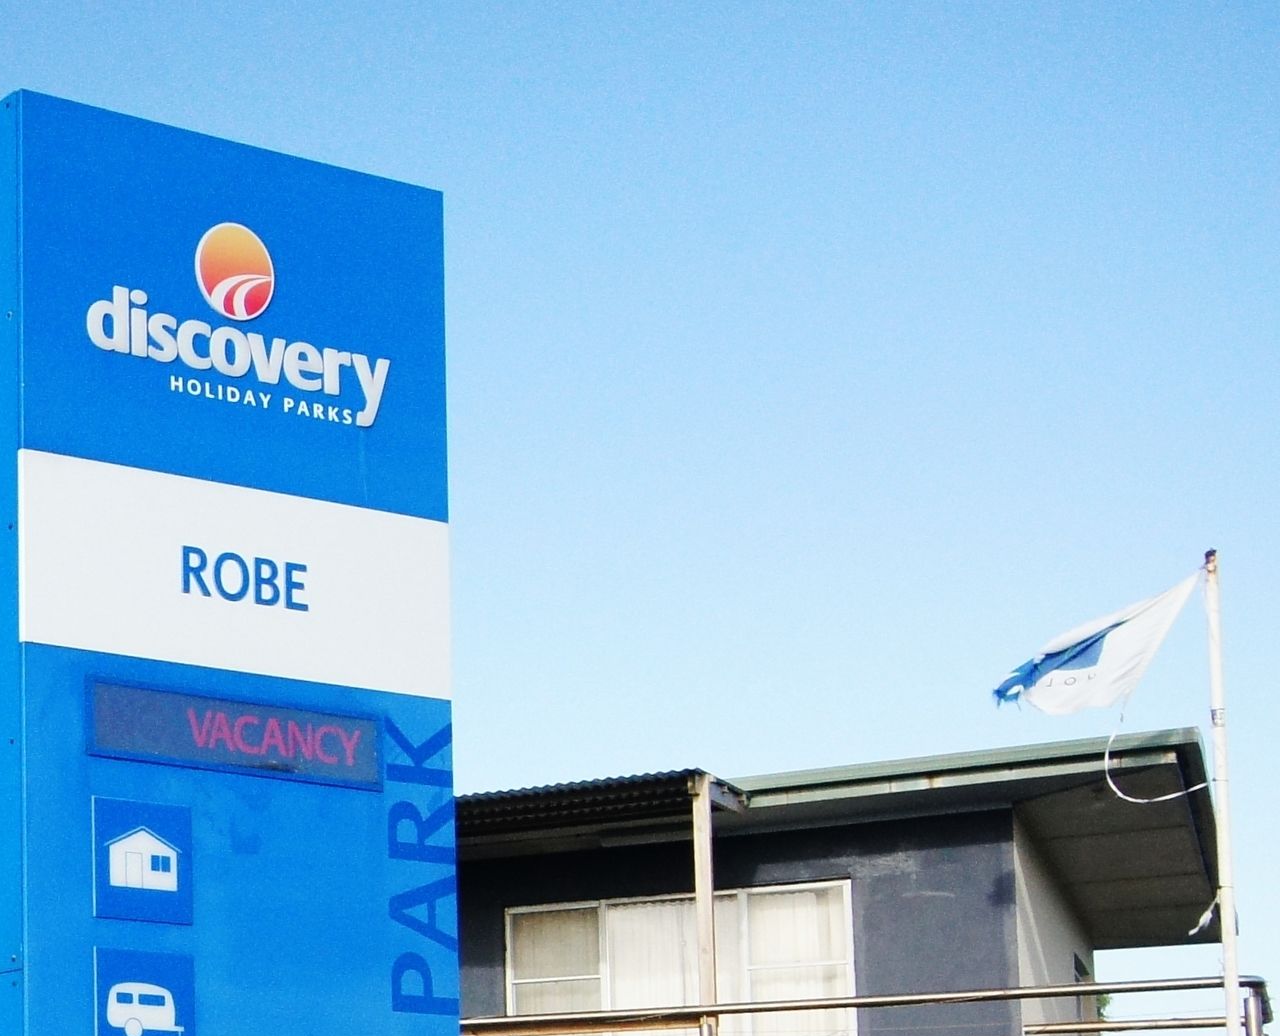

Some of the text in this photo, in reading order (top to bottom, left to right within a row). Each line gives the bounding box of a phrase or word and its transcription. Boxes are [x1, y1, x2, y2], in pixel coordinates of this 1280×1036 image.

[86, 285, 390, 427] discovery
[169, 375, 353, 425] HOLIDAY PARKS
[181, 544, 309, 612] ROBE
[187, 708, 360, 766] VACANCY
[384, 715, 459, 1014] PARK
